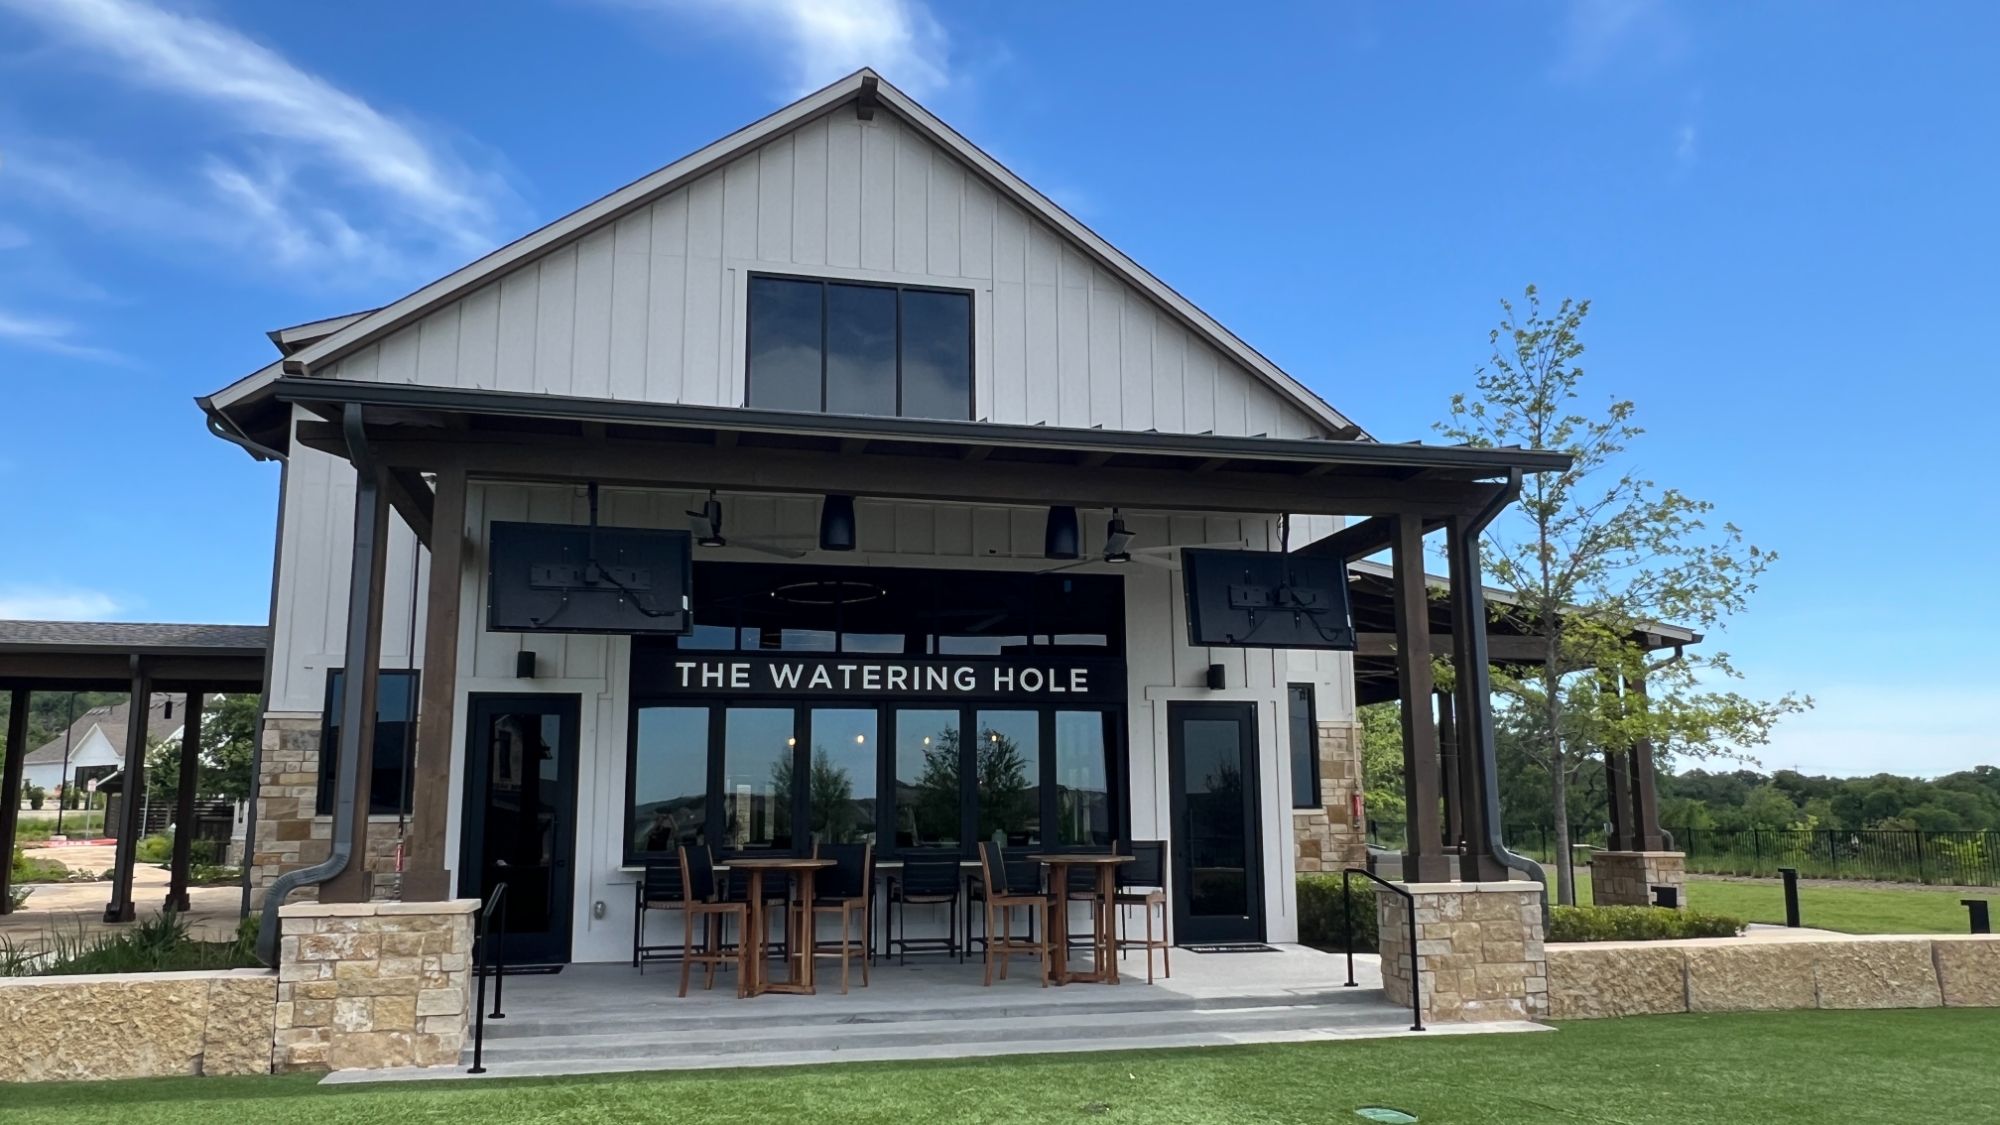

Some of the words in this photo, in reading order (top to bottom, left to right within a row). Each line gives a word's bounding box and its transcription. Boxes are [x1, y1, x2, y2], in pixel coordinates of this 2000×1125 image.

[675, 662, 750, 688] THE
[769, 664, 976, 691] WATERING
[994, 668, 1088, 693] HOLE
